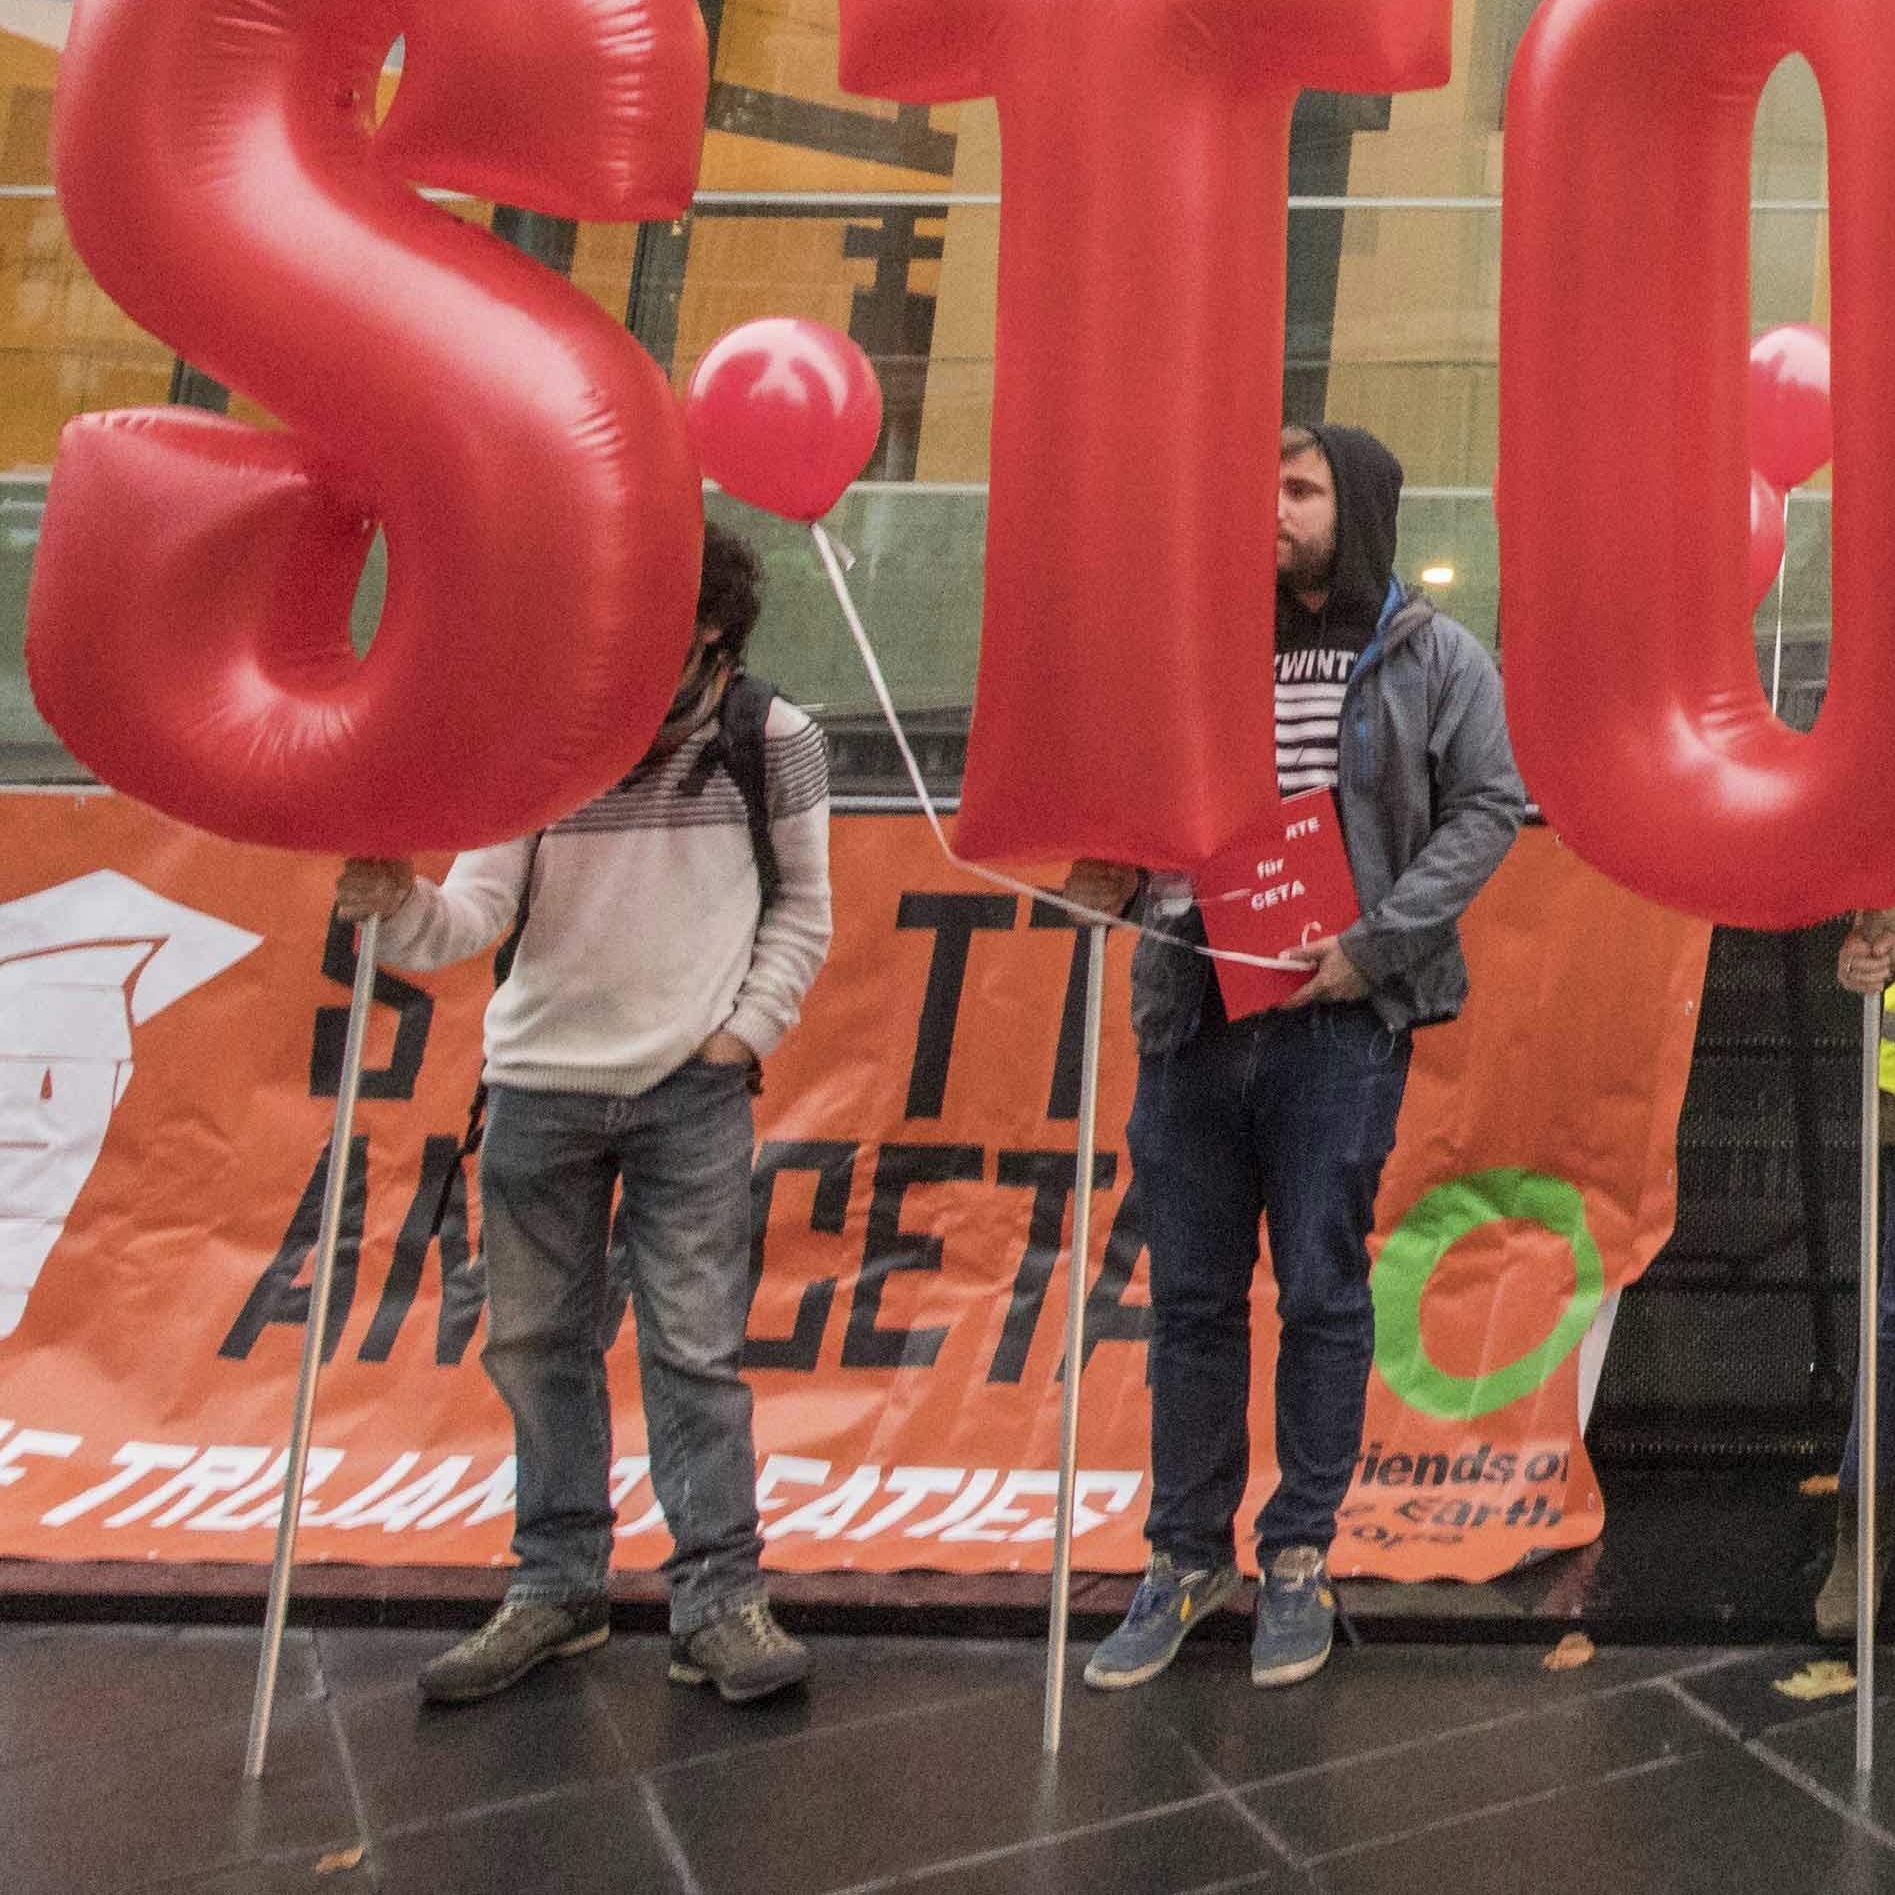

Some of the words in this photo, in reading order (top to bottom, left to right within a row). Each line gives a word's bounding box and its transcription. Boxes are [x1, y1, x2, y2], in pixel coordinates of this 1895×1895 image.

[1275, 649, 1359, 682] WINT
[1256, 857, 1285, 880] für
[1251, 879, 1306, 911] CETA
[1352, 1442, 1516, 1486] iends
